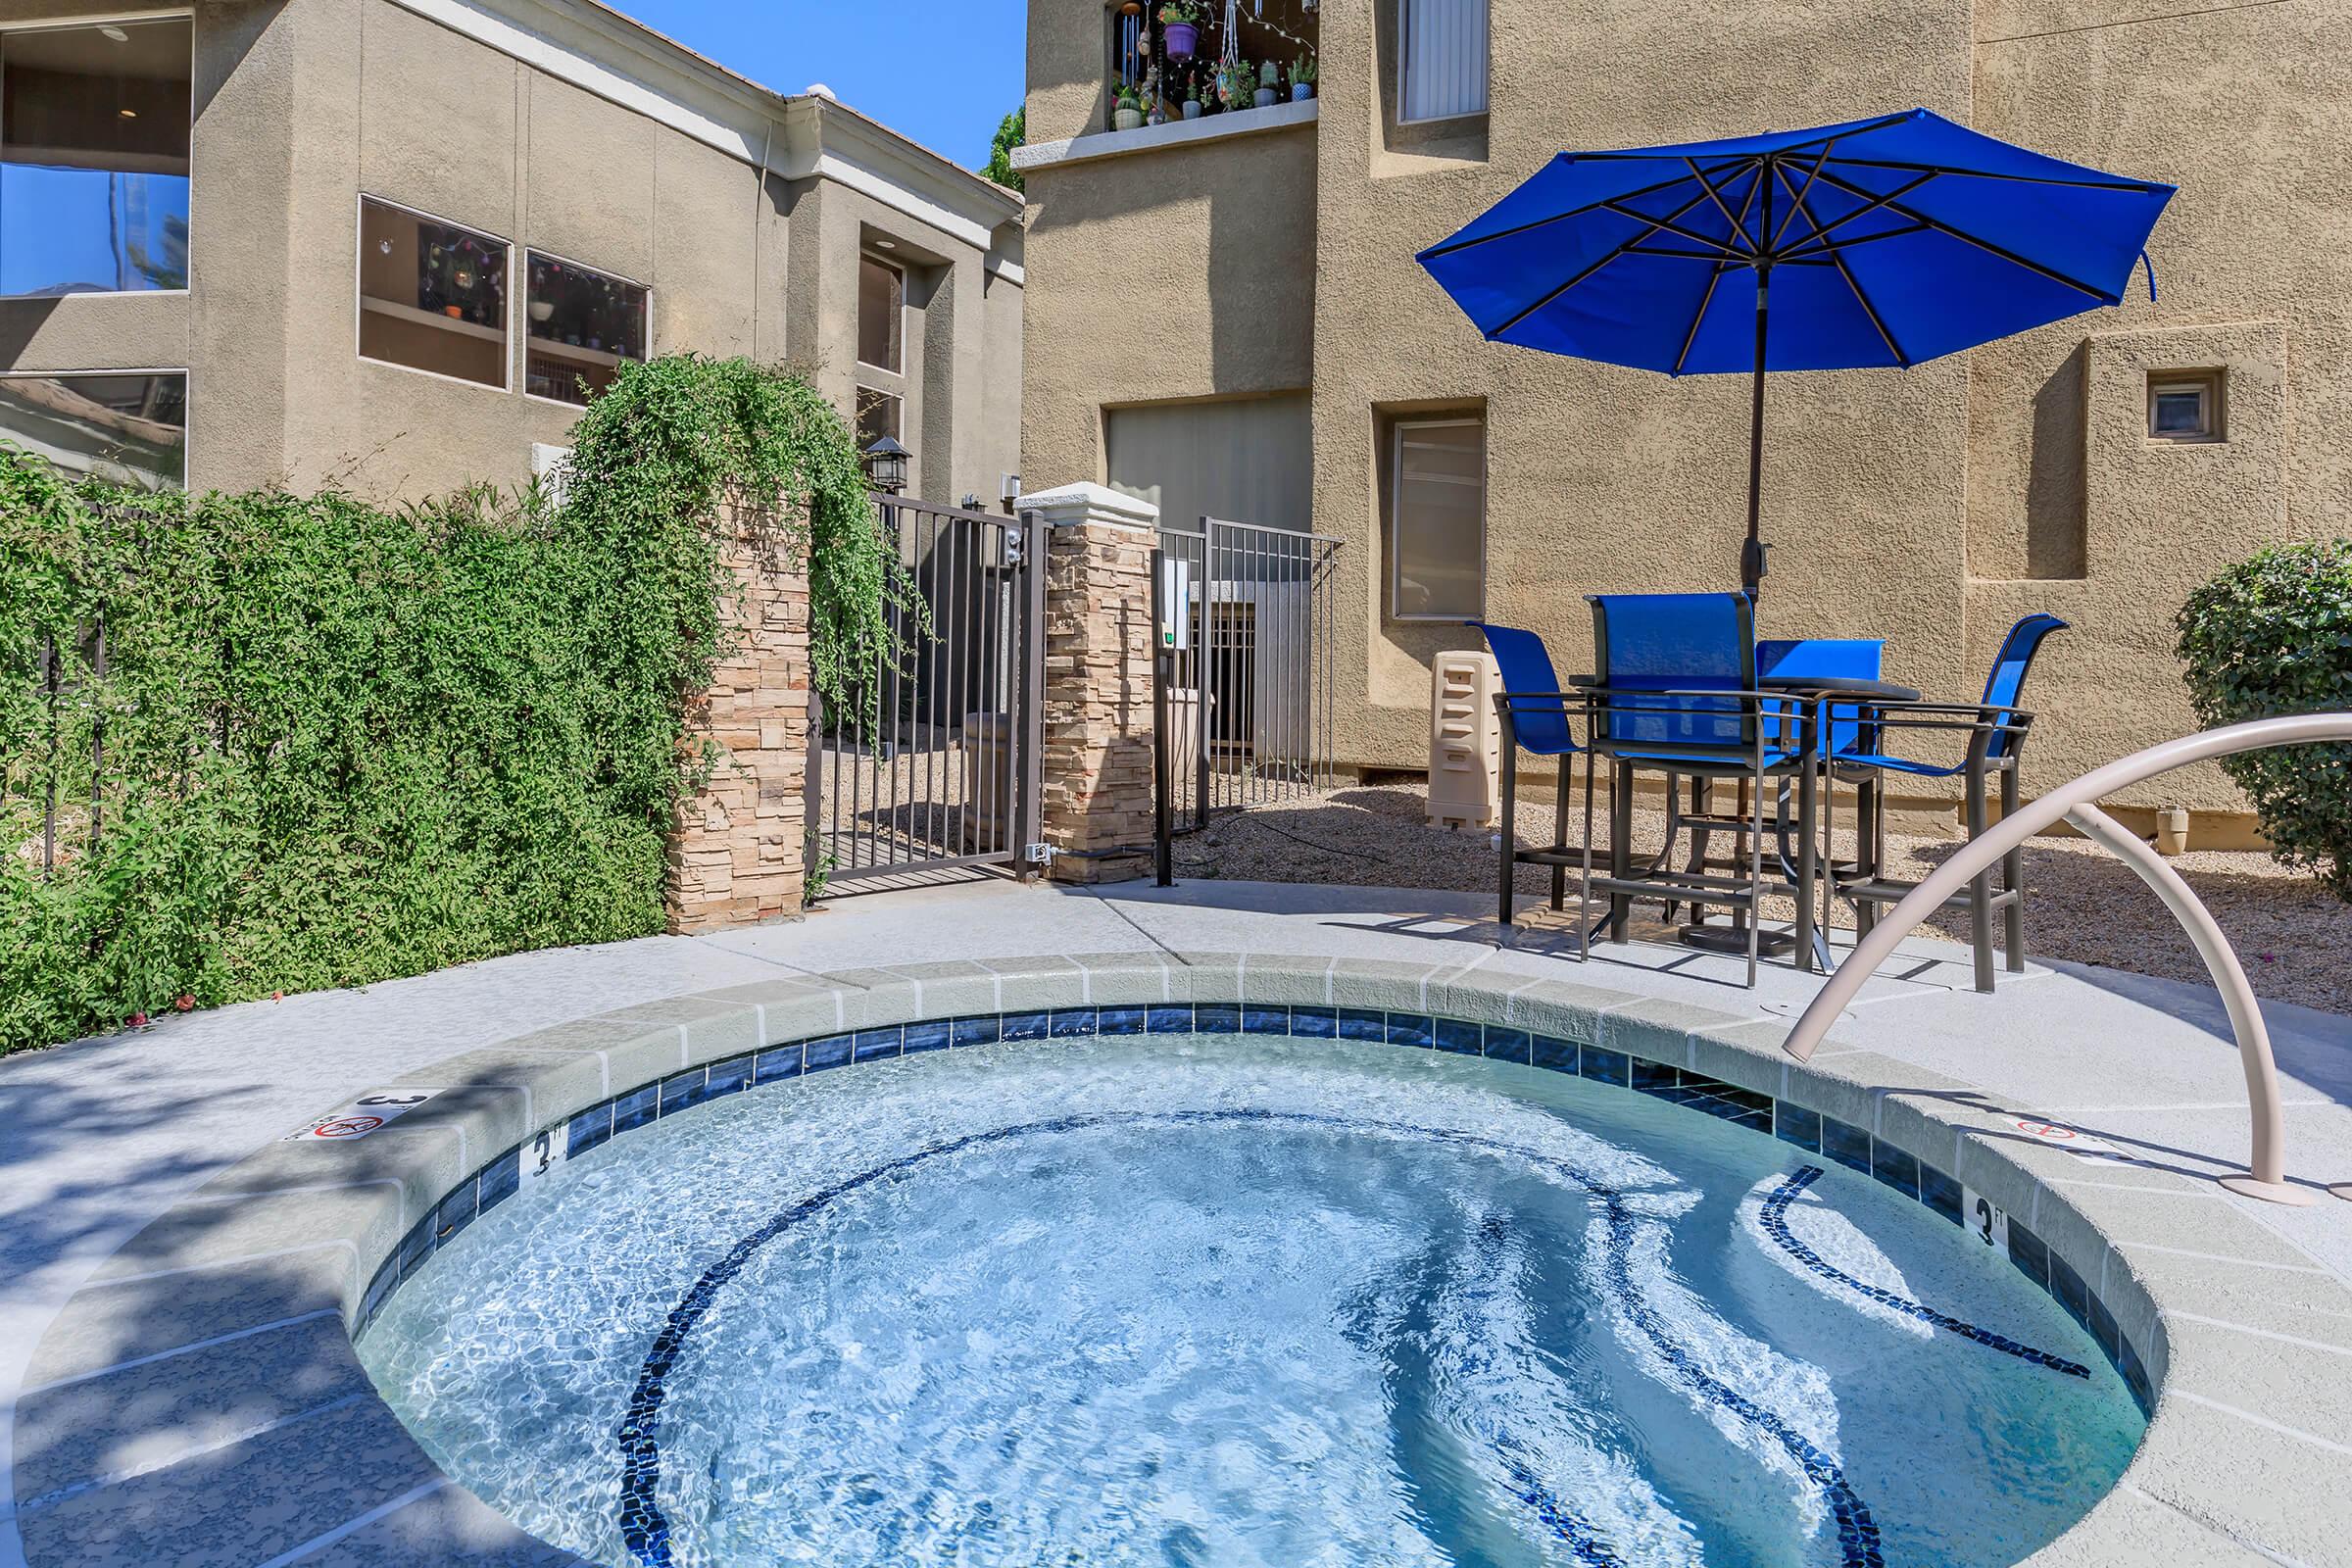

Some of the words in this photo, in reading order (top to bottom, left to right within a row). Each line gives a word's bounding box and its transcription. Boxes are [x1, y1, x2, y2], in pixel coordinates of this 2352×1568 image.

[357, 1095, 428, 1106] 3
[553, 1121, 563, 1140] FT
[1994, 1206, 2003, 1226] FT
